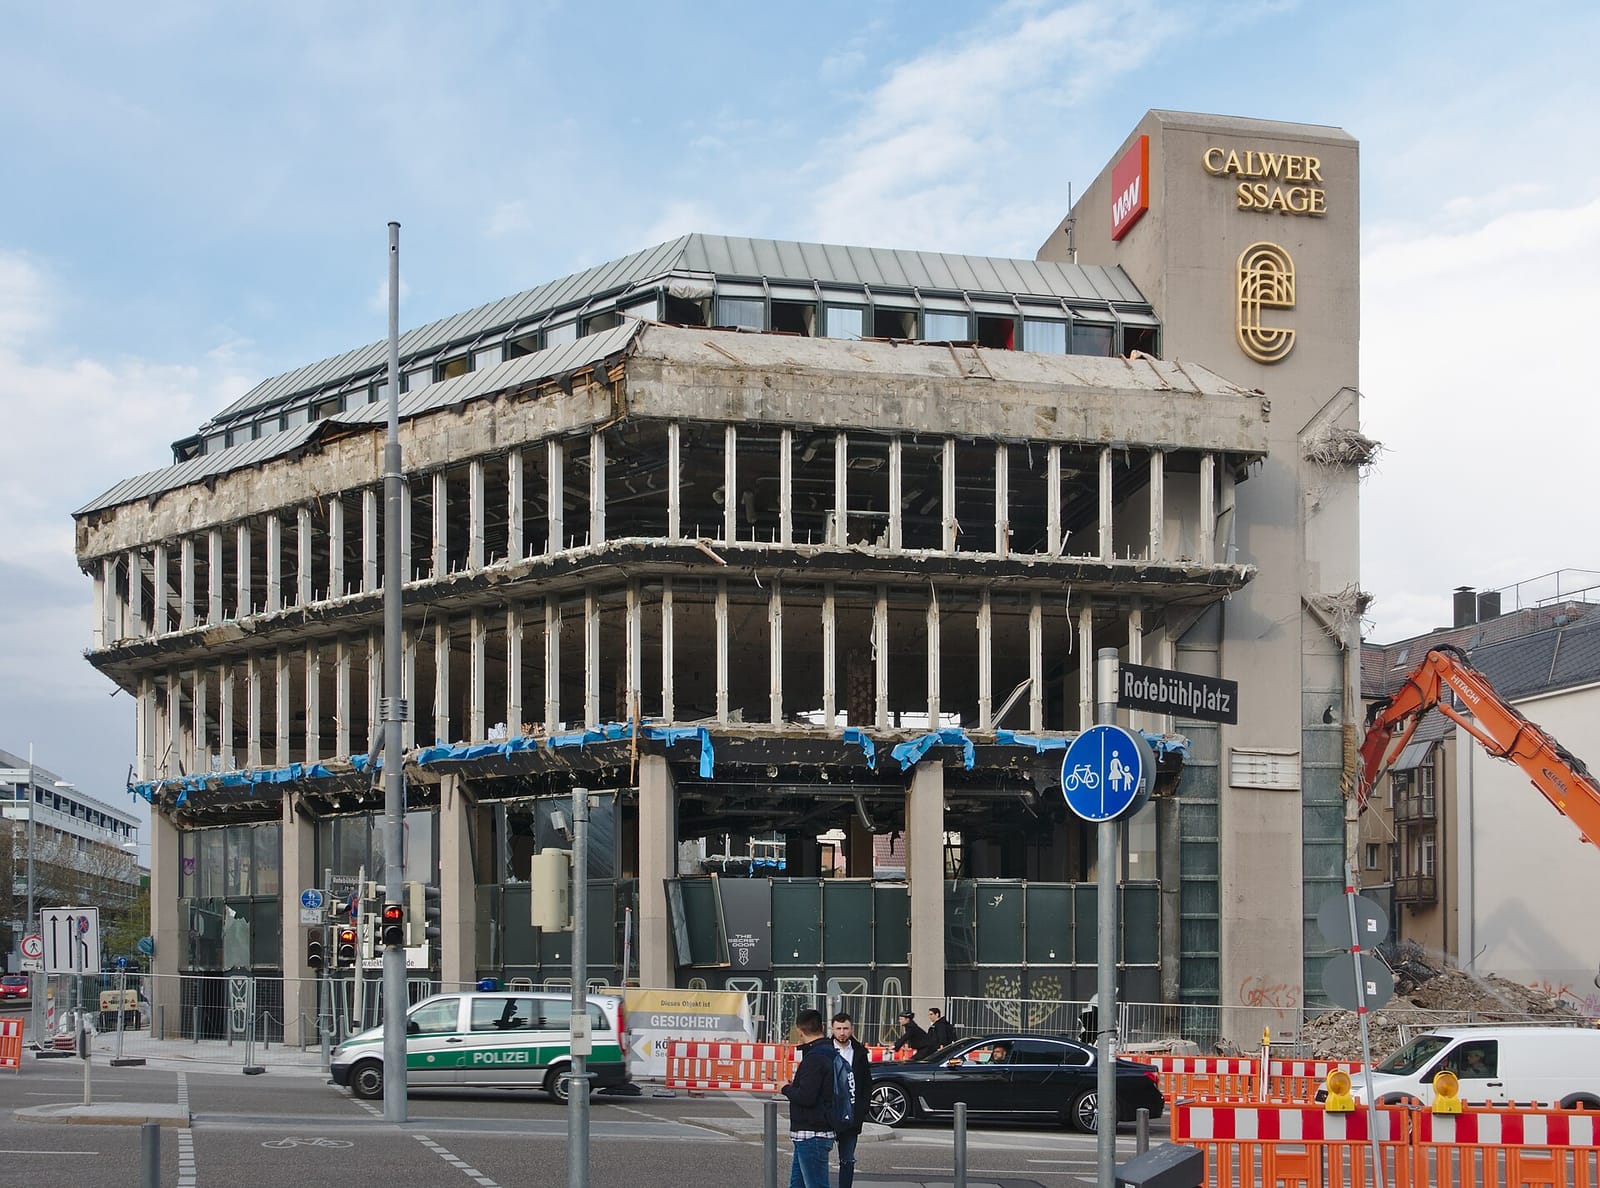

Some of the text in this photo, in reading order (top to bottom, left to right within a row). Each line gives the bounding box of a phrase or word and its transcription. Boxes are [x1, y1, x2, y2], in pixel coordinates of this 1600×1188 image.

[1203, 147, 1323, 182] CALWER
[1237, 182, 1327, 214] SSAGE
[1124, 671, 1230, 714] Rotebühlplatz
[1451, 675, 1480, 704] HITACHI
[606, 1000, 614, 1010] 5
[681, 1000, 701, 1008] Objekt
[650, 1015, 720, 1029] GESICHERT
[473, 1051, 529, 1064] POLIZEI
